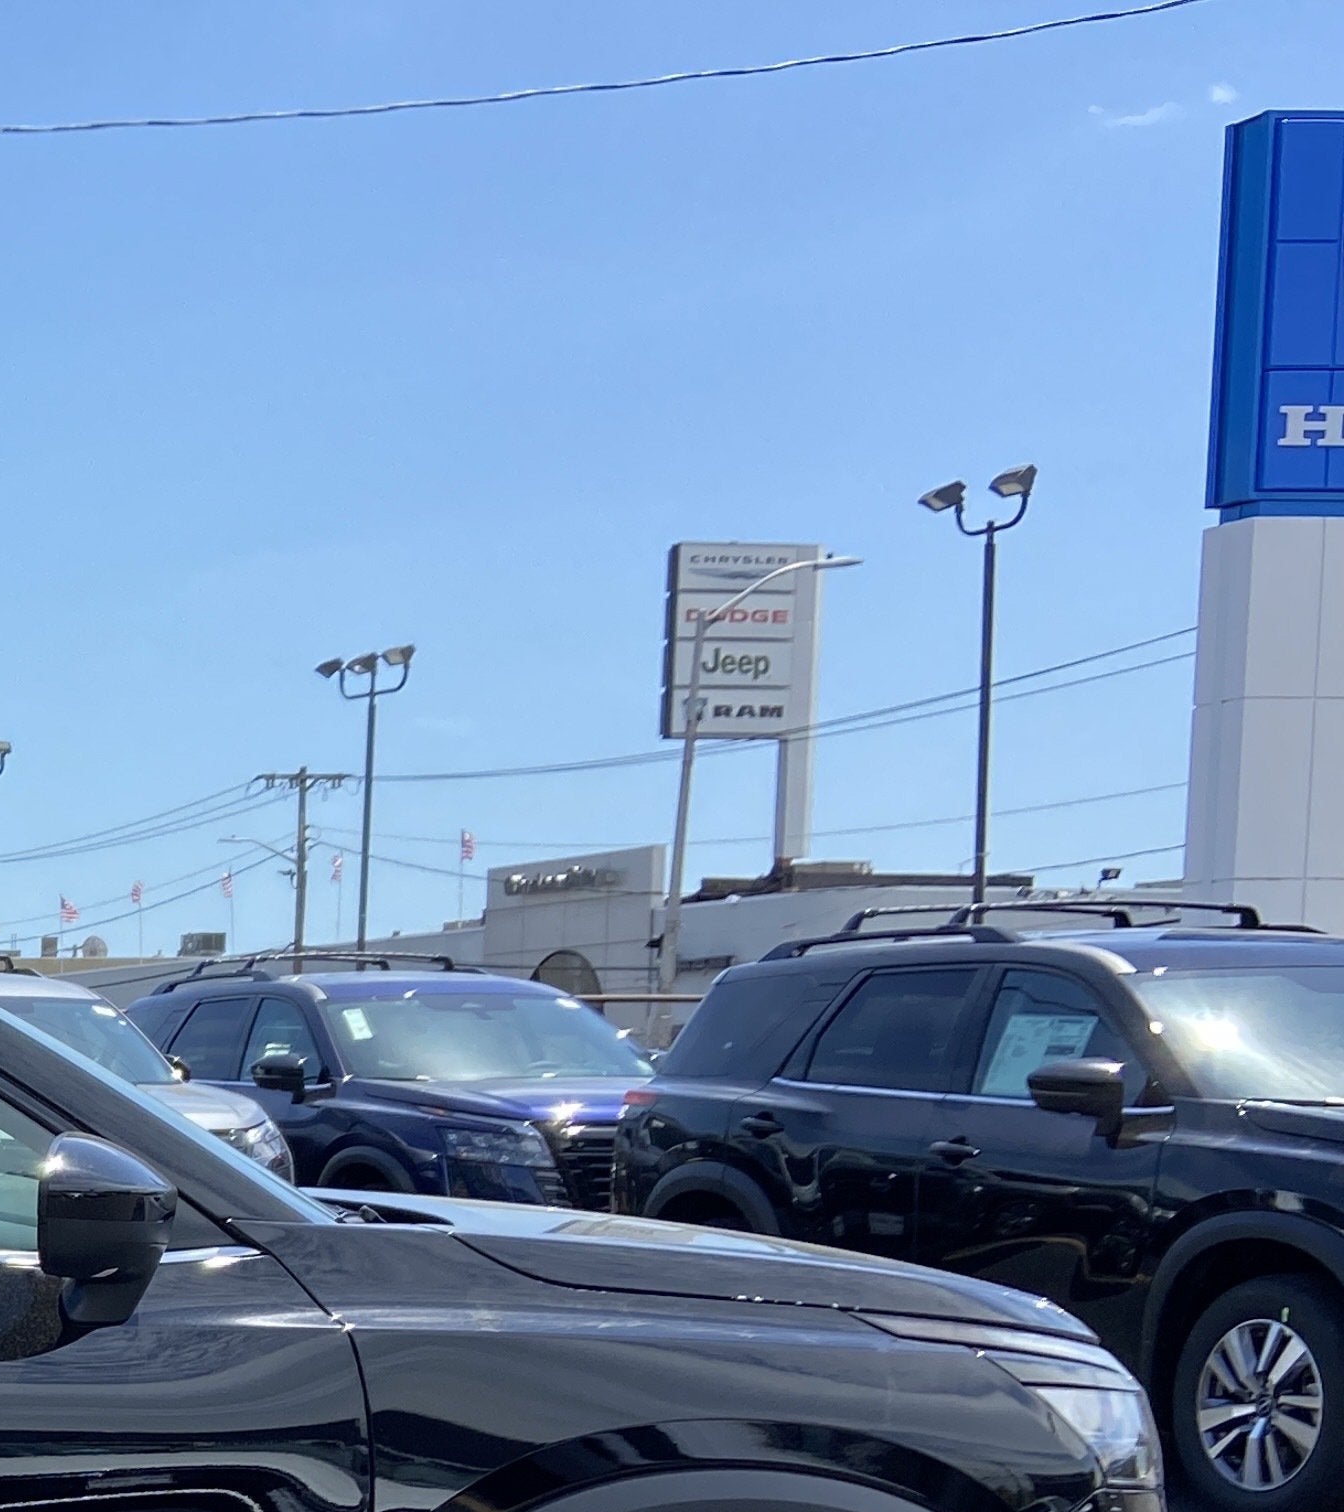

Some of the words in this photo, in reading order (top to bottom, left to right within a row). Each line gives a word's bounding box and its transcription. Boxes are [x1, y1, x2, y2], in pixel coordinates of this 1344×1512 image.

[689, 554, 789, 565] CHRYSLER
[702, 647, 770, 680] Jeep
[713, 704, 784, 718] RAM
